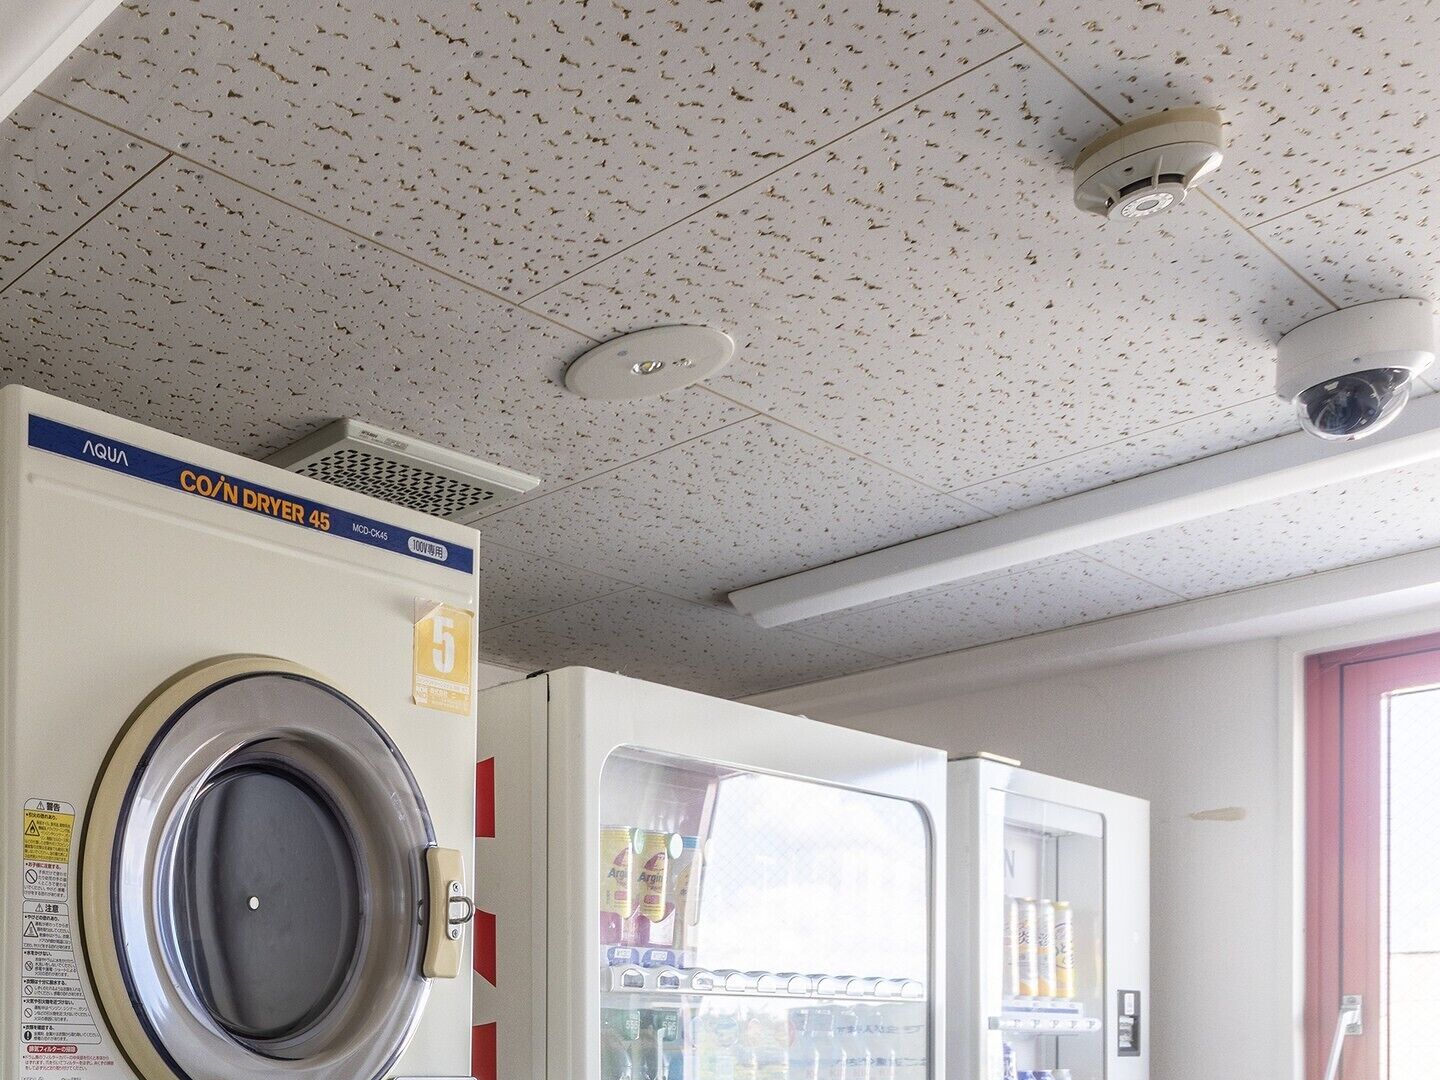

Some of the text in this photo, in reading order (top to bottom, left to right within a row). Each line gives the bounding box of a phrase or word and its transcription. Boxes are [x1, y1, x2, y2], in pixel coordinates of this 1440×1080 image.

[82, 440, 388, 542] AQUA COIN DRYER 45 MCD-CK45
[412, 538, 444, 560] 100V専用
[432, 615, 455, 673] 5
